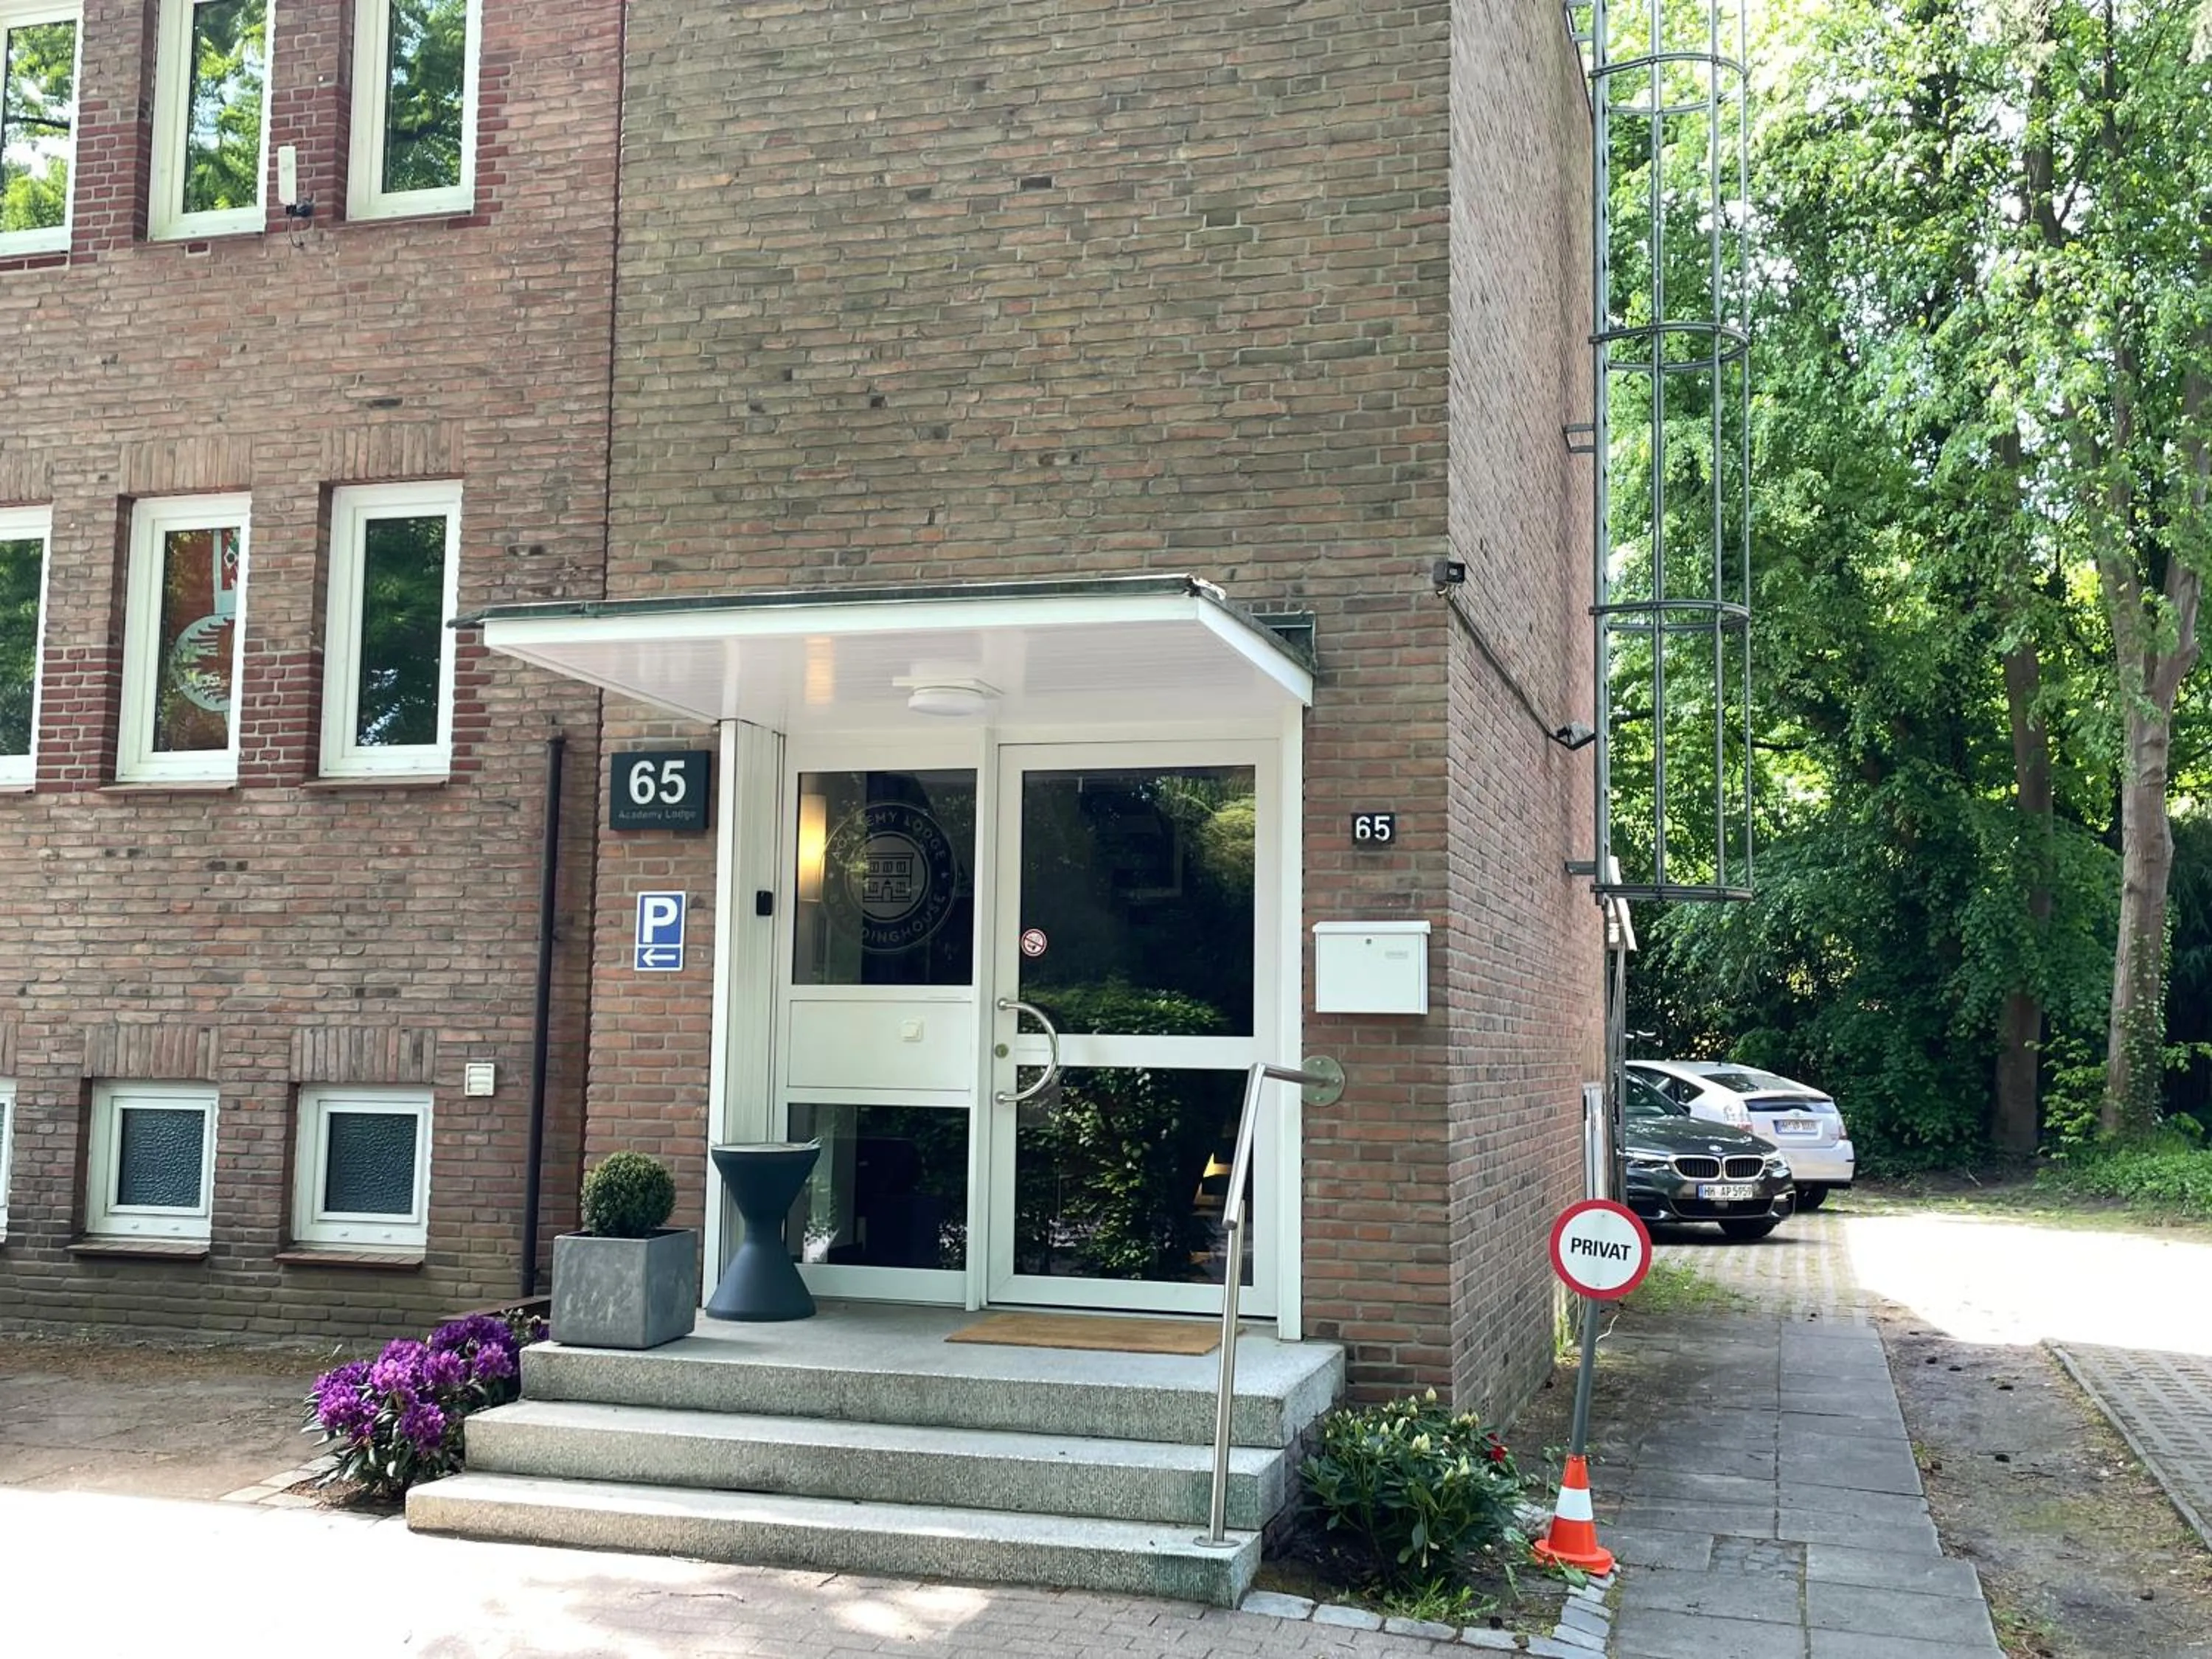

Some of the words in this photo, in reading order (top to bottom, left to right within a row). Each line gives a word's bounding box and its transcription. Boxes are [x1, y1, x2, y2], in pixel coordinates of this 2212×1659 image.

[629, 759, 686, 804] 65
[1355, 815, 1390, 841] 65
[643, 897, 678, 943] P
[1571, 1237, 1632, 1261] PRIVAT
